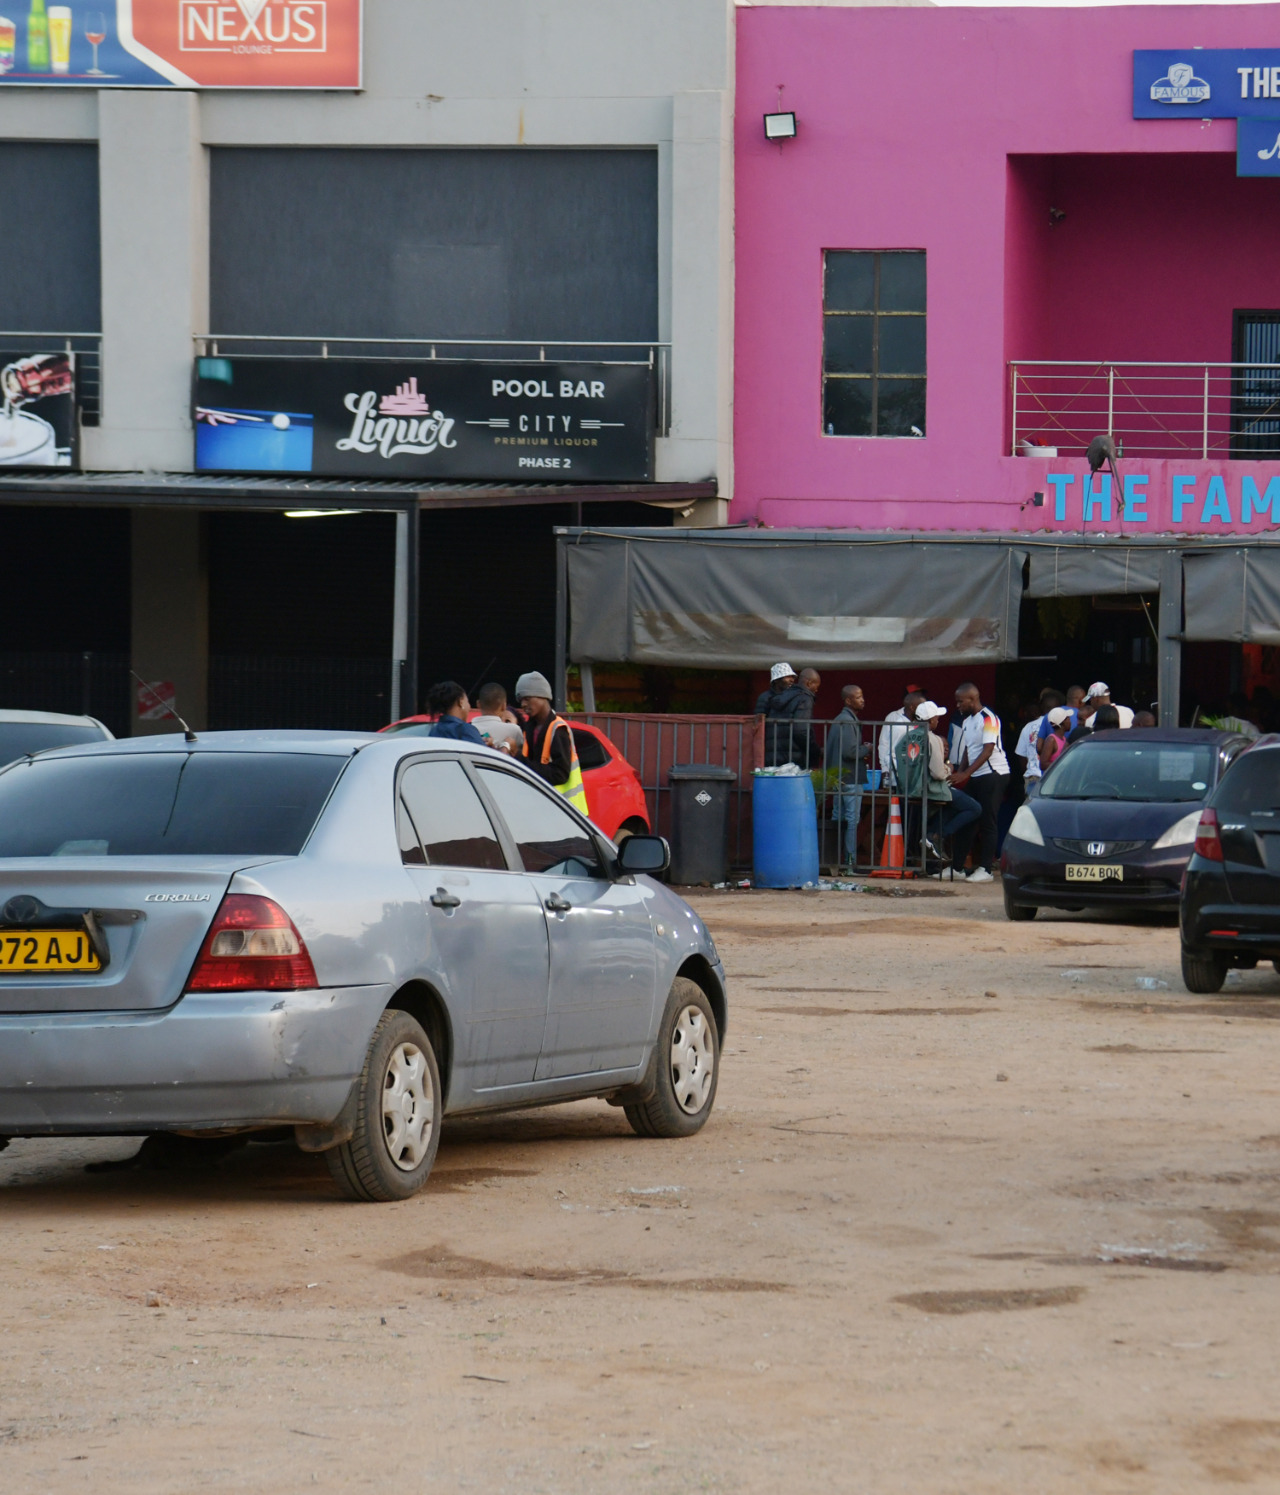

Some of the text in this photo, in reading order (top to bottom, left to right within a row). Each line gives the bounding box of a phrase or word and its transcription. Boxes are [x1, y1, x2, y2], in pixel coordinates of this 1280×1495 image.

[187, 4, 316, 43] NEXUS
[232, 45, 273, 54] LOUNGE
[1153, 87, 1206, 98] FAMOUS
[492, 379, 606, 398] POOL BAR
[335, 390, 458, 459] Liquor
[519, 414, 572, 433] CITY
[494, 436, 599, 447] PREMIUM LIQUOR
[518, 457, 571, 468] PHASE 2
[1046, 473, 1149, 523] THE
[145, 893, 211, 903] COROLLA
[0, 937, 39, 964] 72
